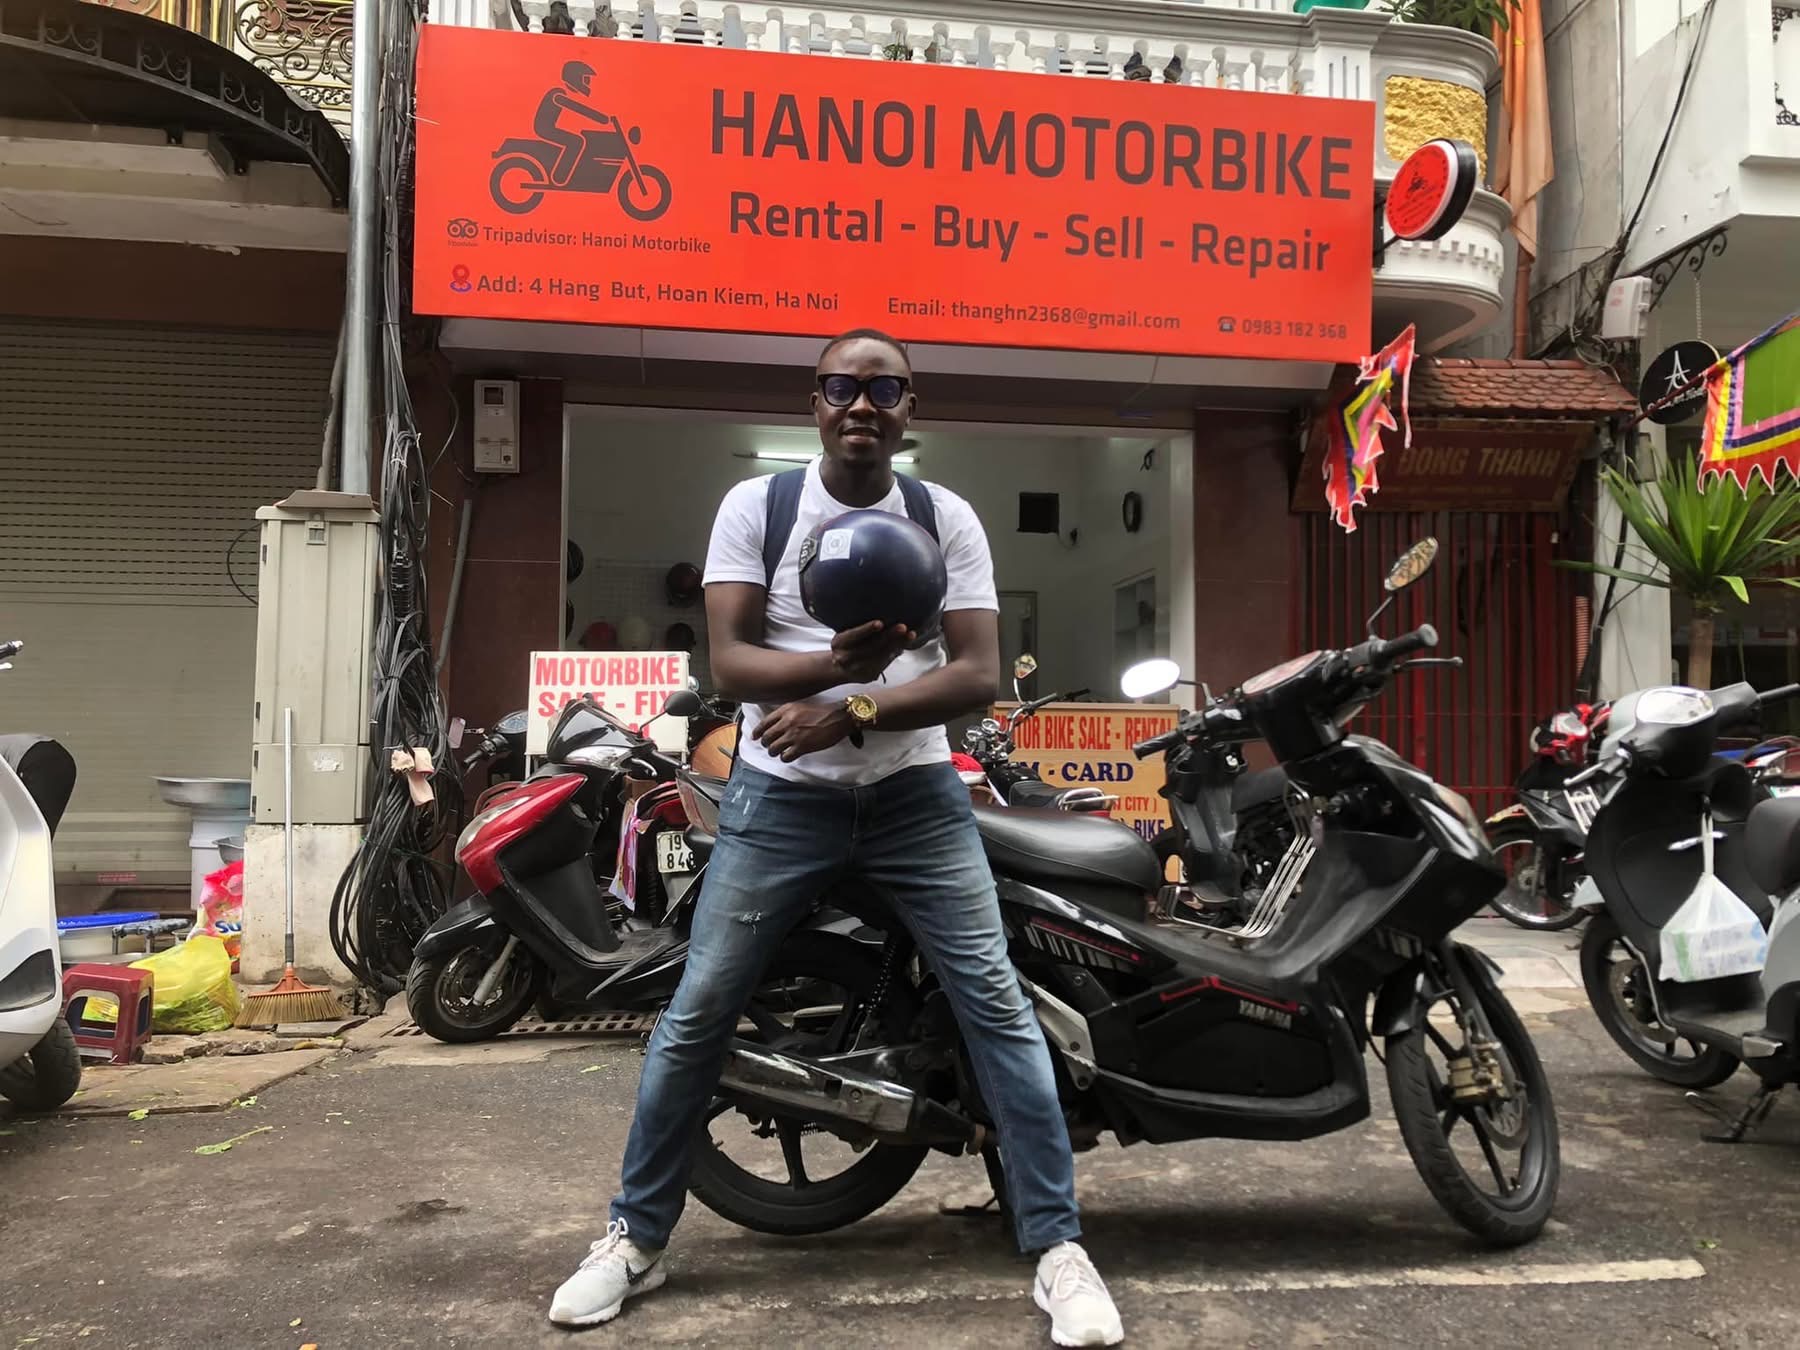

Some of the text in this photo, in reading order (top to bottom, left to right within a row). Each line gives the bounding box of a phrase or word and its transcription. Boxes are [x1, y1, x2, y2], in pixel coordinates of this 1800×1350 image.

[711, 88, 937, 169] HANOI
[961, 107, 1353, 200] MOTORBIKE
[483, 227, 711, 253] Tripadvisor: Hanoi Motorbike
[730, 191, 1332, 279] Rental - Buy - Sell - Repair
[477, 275, 839, 310] Add: 4 Hang But, Hoan Kiem, Ha Noi
[888, 298, 1181, 330] Email: thanghn2368@gmail.com
[535, 657, 680, 686] MOTORBIKE
[1045, 715, 1074, 750] BIKE
[1079, 716, 1111, 750] SALE
[1061, 762, 1134, 782] CARD
[1125, 796, 1150, 812] CITY
